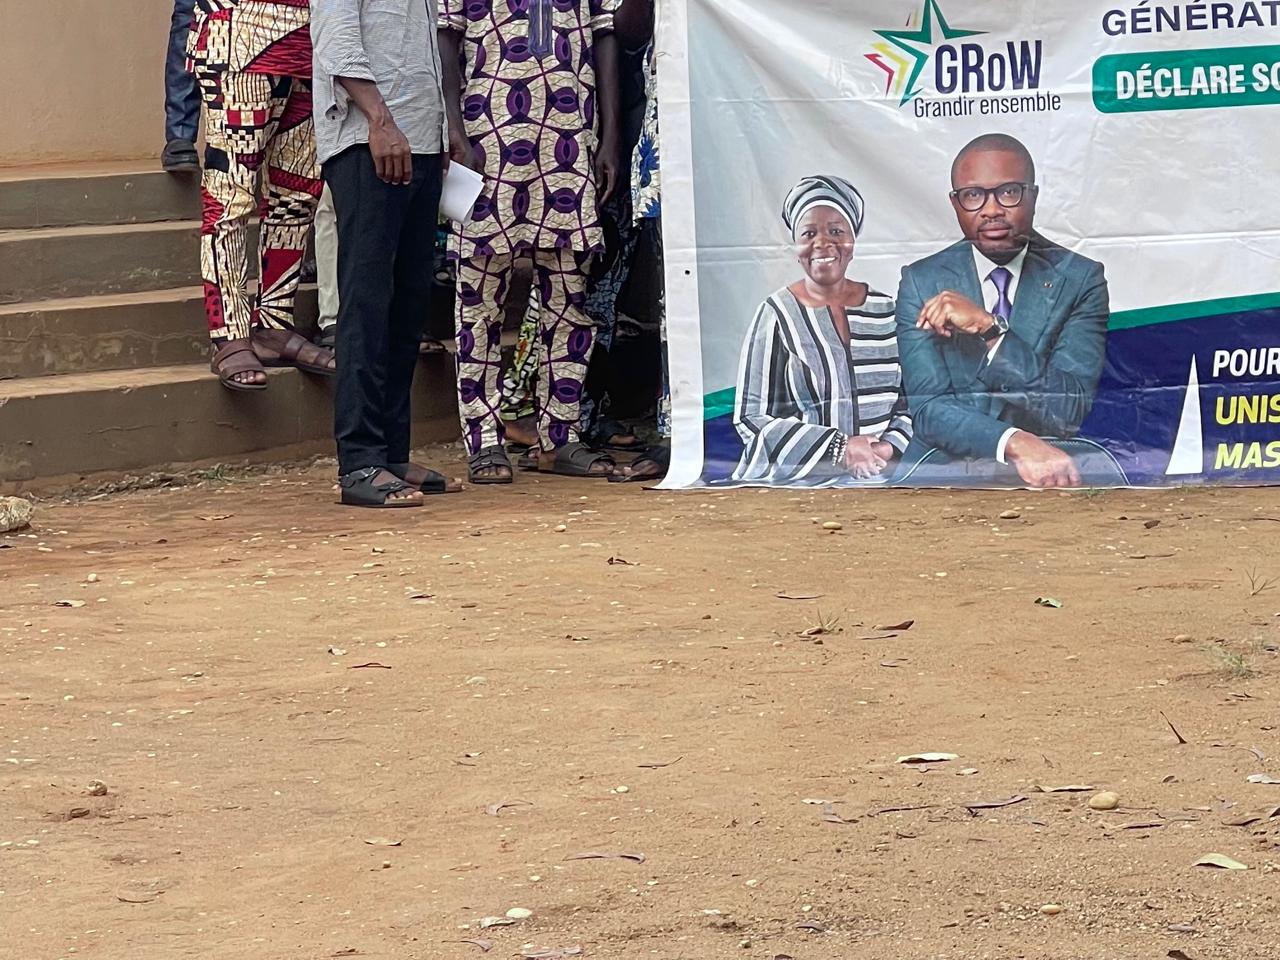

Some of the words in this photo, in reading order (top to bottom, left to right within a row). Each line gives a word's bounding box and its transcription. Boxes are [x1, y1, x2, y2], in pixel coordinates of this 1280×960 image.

[935, 40, 1042, 94] GRoW
[1116, 64, 1245, 100] DÉCLARE
[914, 96, 975, 118] Grandir
[980, 91, 1061, 114] ensemble
